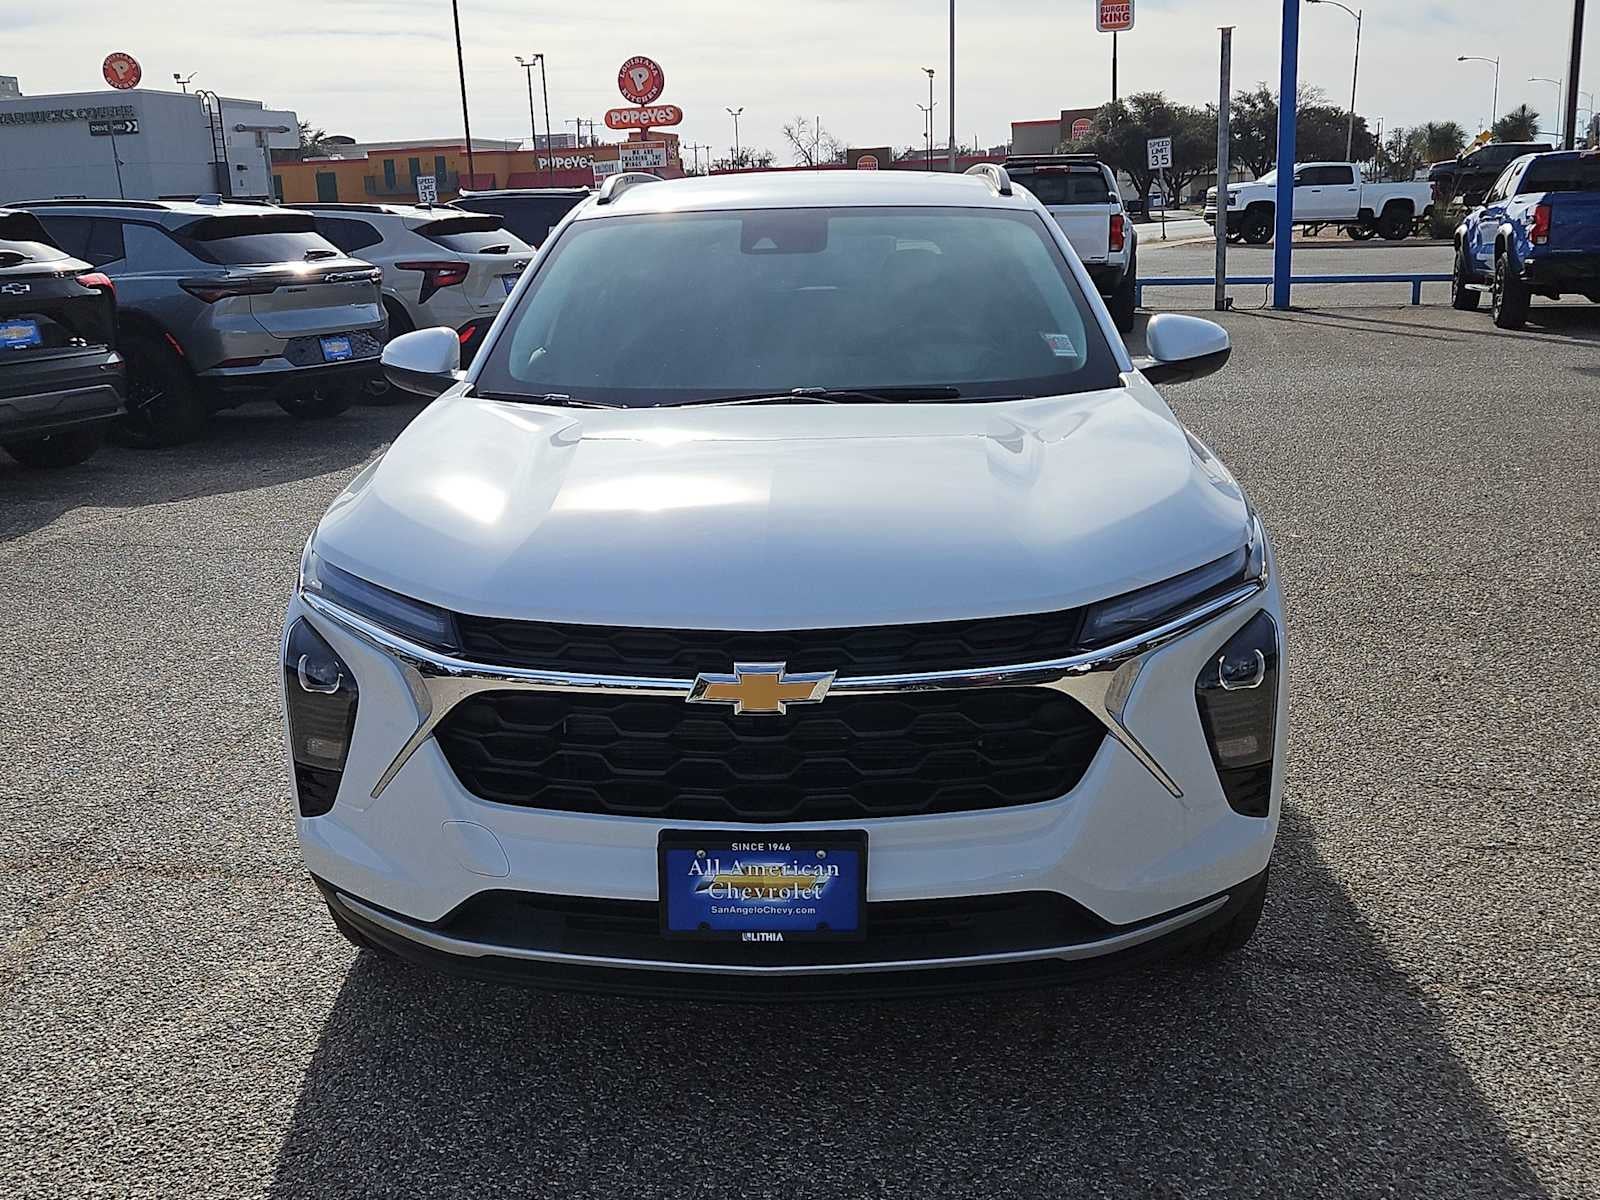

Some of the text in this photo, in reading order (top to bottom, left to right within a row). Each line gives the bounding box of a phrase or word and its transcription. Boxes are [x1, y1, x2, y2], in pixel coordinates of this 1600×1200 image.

[1100, 4, 1130, 13] BURGER
[1100, 12, 1130, 23] KING
[620, 58, 658, 78] LOUISIANA
[629, 67, 649, 92] P
[621, 86, 658, 102] KITCHEN
[1149, 140, 1171, 148] SPEED
[1151, 147, 1168, 155] LIMIT
[1151, 154, 1169, 166] 35
[420, 191, 435, 202] 35
[731, 842, 791, 851] SINCE 1946
[688, 859, 840, 877] All American
[708, 881, 822, 900] Chevrolet
[711, 905, 816, 915] SanAngeloChevy.com
[751, 932, 784, 942] LITHIA
